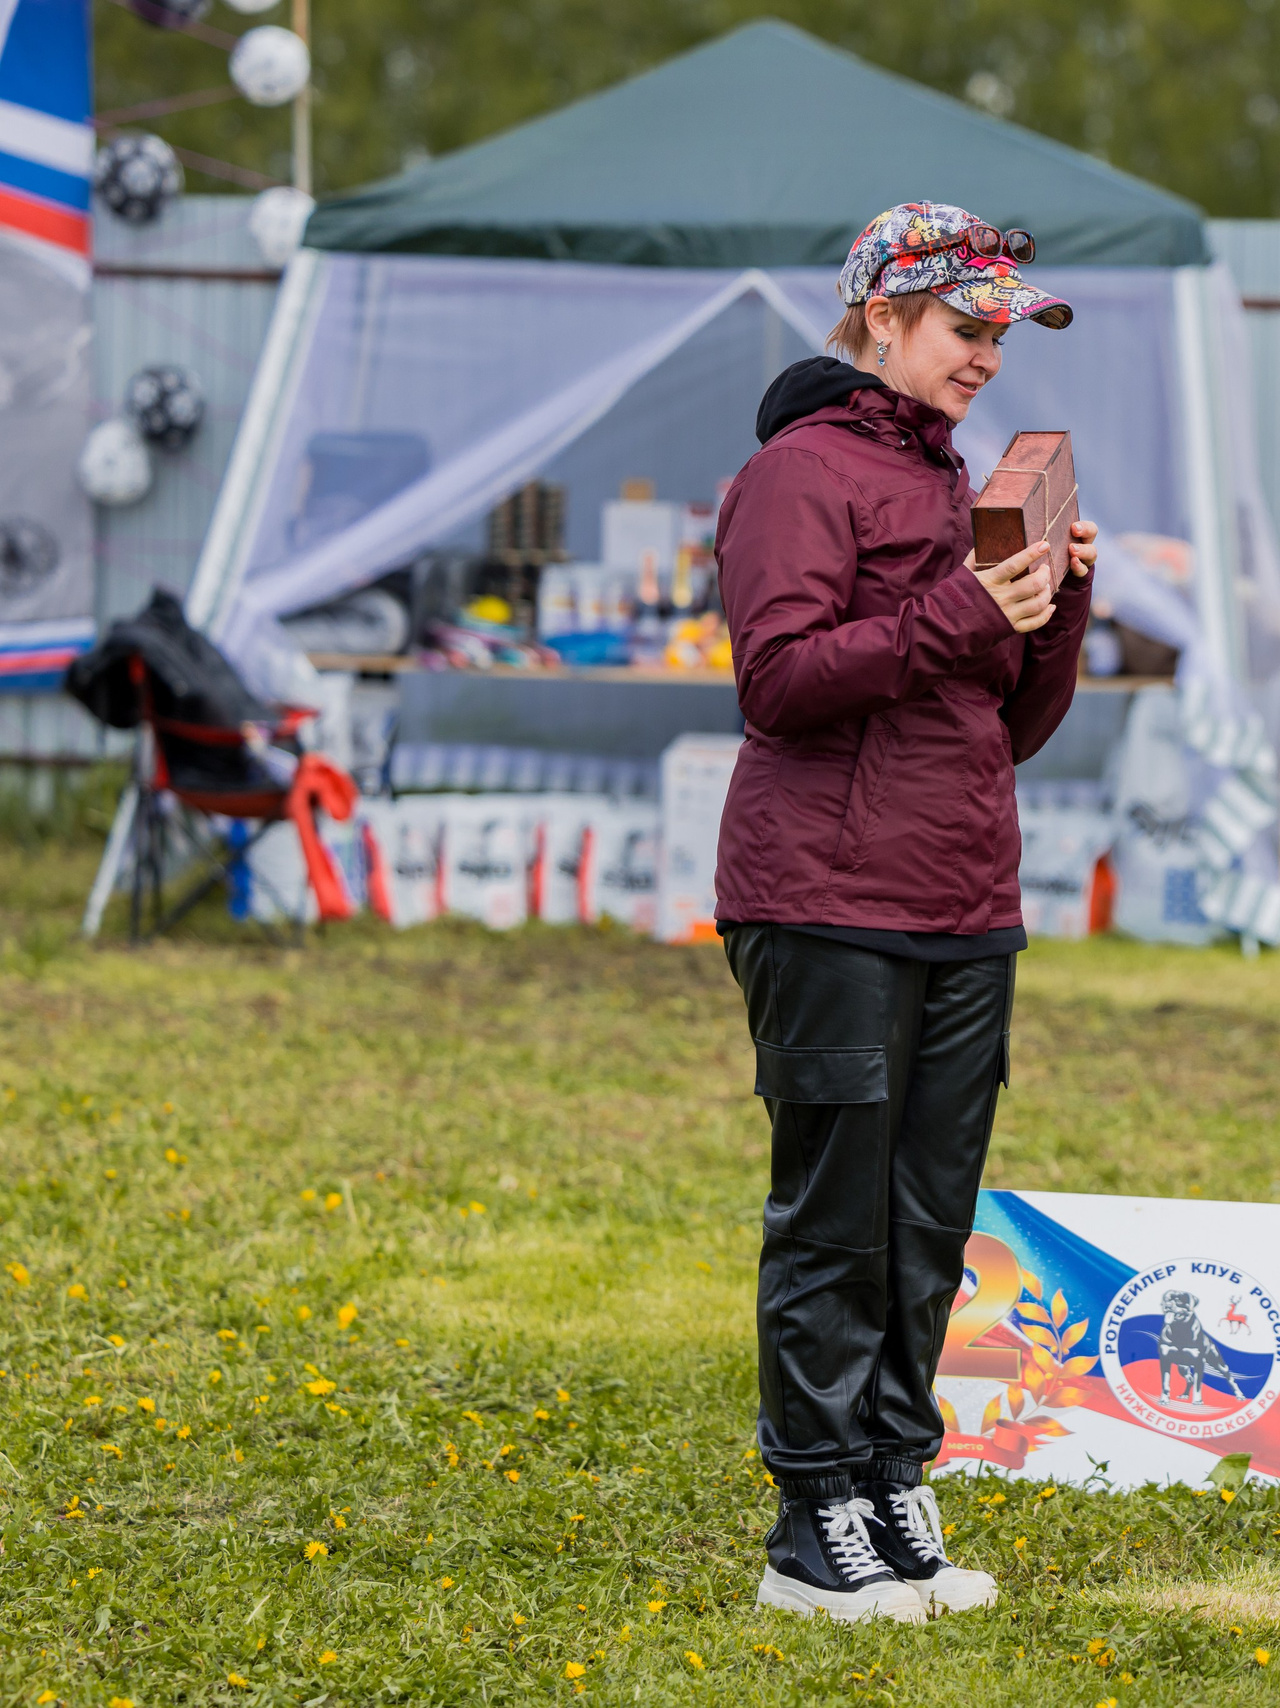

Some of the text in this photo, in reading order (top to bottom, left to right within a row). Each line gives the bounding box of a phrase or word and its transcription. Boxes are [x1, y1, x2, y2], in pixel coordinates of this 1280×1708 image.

[936, 1231, 1022, 1381] 2
[1105, 1264, 1177, 1355] РОТВЕЙЛЕР
[1190, 1262, 1243, 1285] КЛУБ
[1115, 1383, 1276, 1438] НИЖЕГОРОДСКОЕ РО
